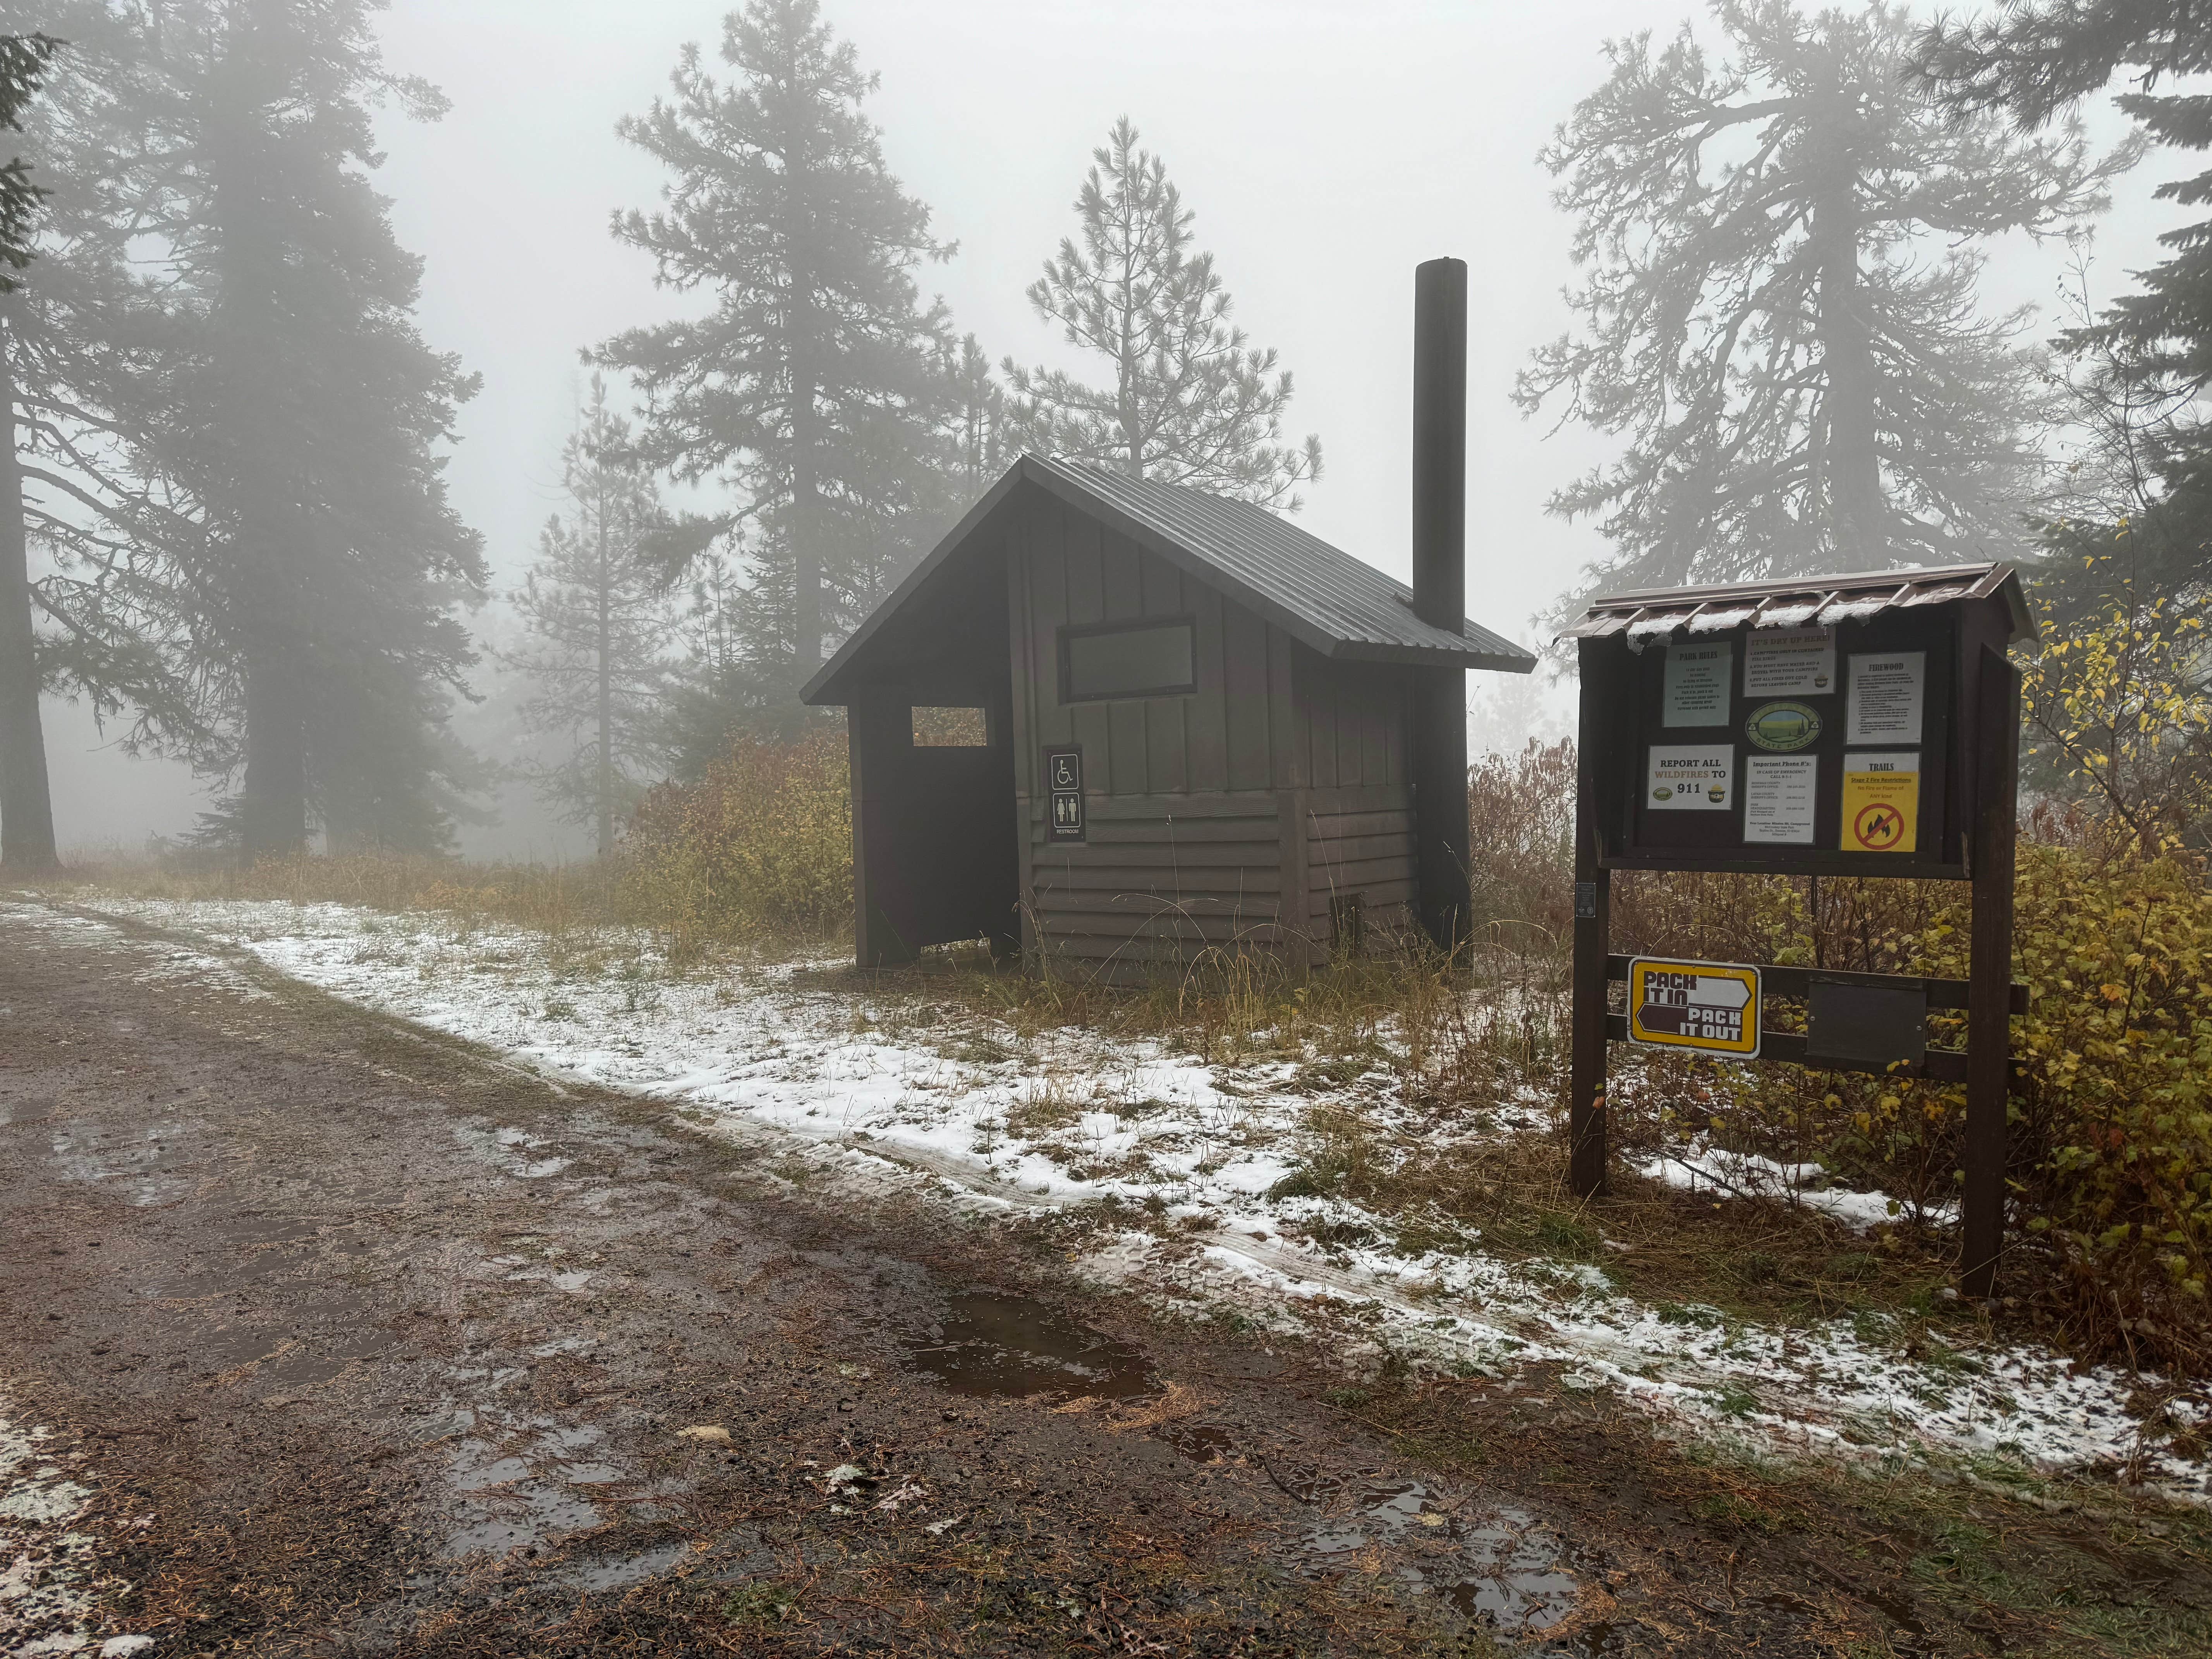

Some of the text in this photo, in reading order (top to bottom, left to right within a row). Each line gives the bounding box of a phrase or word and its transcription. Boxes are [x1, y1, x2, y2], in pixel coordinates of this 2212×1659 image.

[1680, 651, 1718, 661] PARK RULES
[1869, 663, 1903, 671] FIREWOOD
[1756, 737, 1810, 749] STATE PARK
[1869, 763, 1894, 771] TRAILS
[1678, 783, 1700, 793] 911
[1644, 971, 1697, 990] PACK
[1644, 987, 1687, 1005] IT IN
[1688, 1008, 1741, 1025] PACK
[1680, 1022, 1741, 1041] IT OUT
